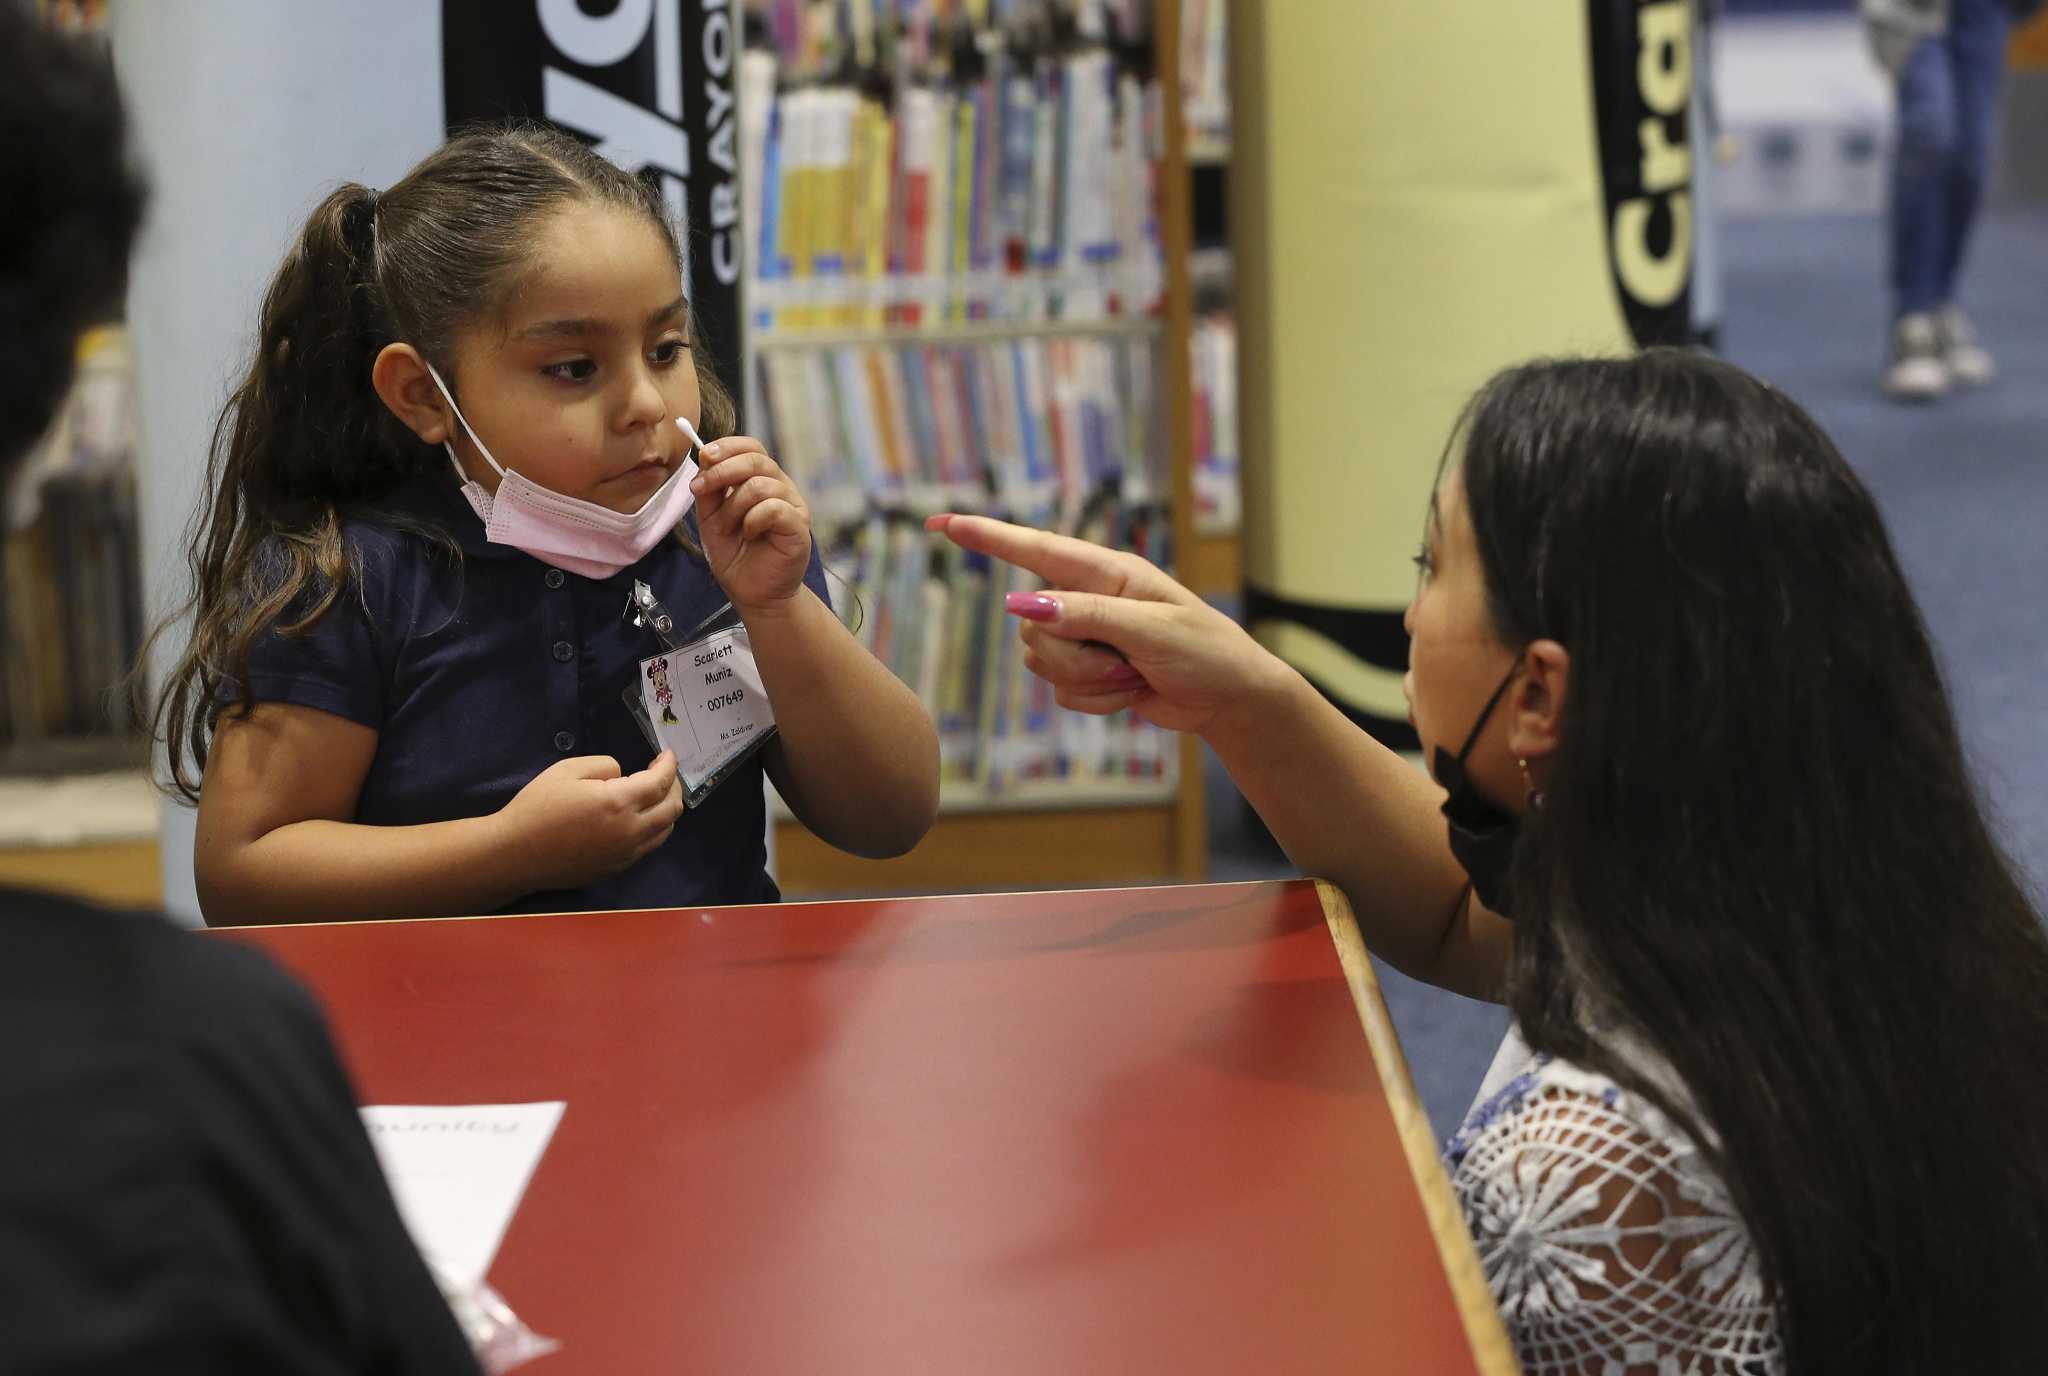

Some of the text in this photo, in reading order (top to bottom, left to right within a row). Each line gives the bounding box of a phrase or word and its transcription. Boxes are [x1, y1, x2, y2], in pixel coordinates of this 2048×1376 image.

[701, 0, 741, 285] CRAYO
[694, 644, 732, 667] Scarlett
[705, 667, 733, 685] Muniz
[707, 689, 744, 711] 007649
